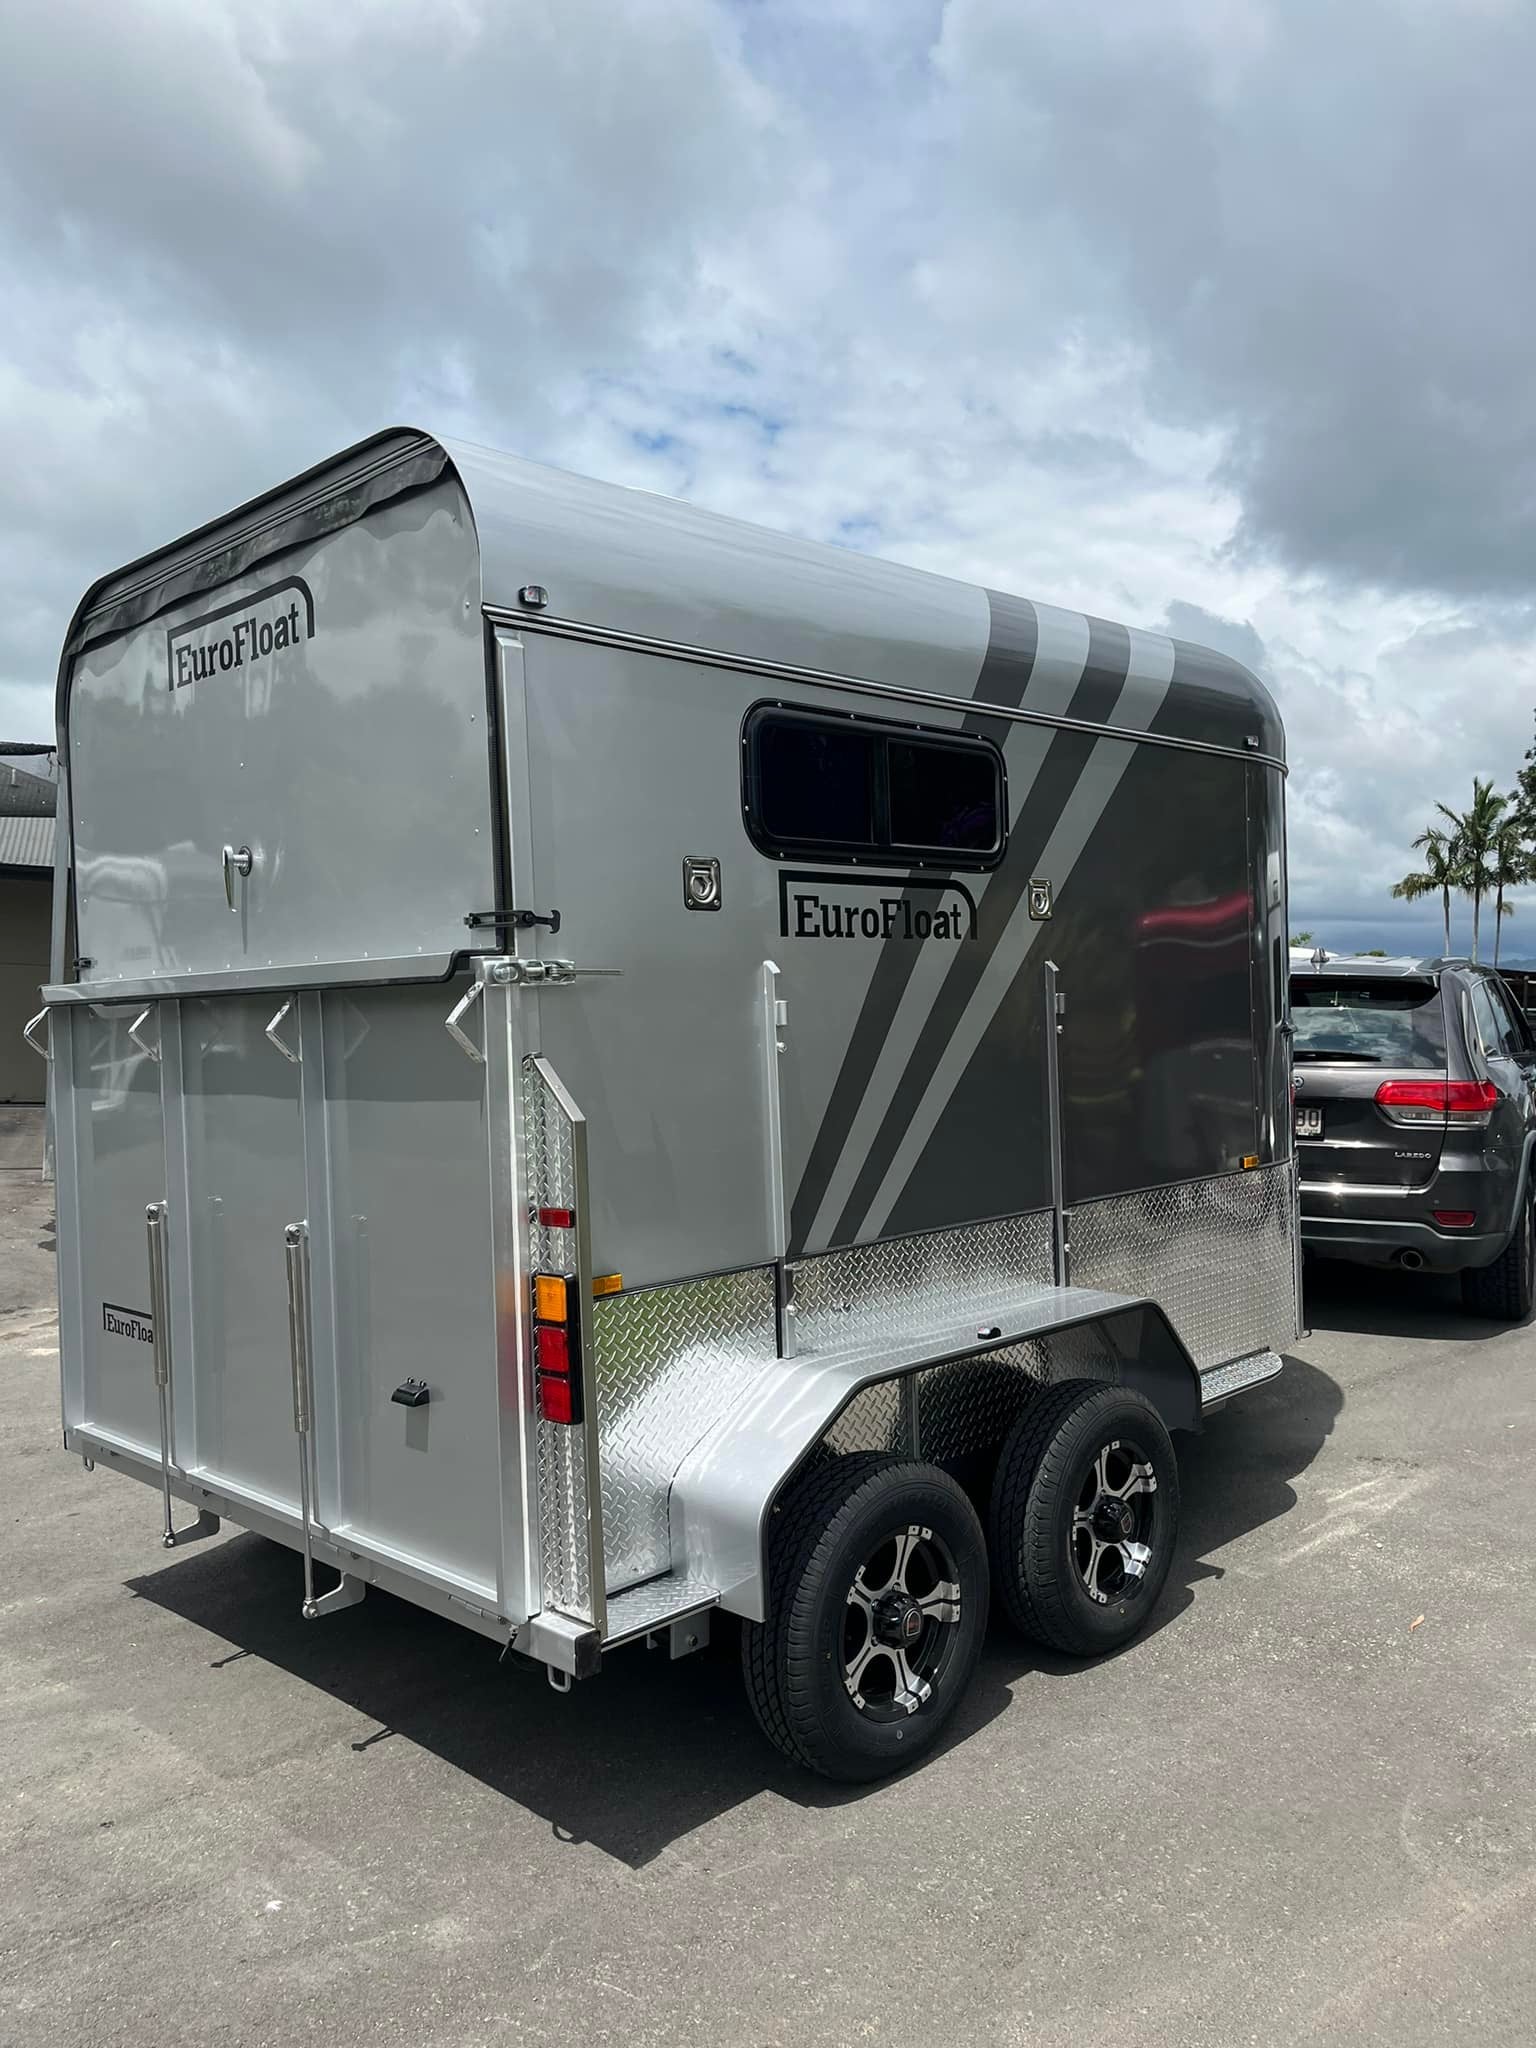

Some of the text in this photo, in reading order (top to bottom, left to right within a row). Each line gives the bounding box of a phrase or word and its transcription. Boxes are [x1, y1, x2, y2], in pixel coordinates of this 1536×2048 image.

[176, 602, 300, 688] EuroFloat
[793, 894, 962, 940] EuroFloat
[1394, 1151, 1432, 1159] LAREDO
[106, 1313, 154, 1345] EuroFloa
